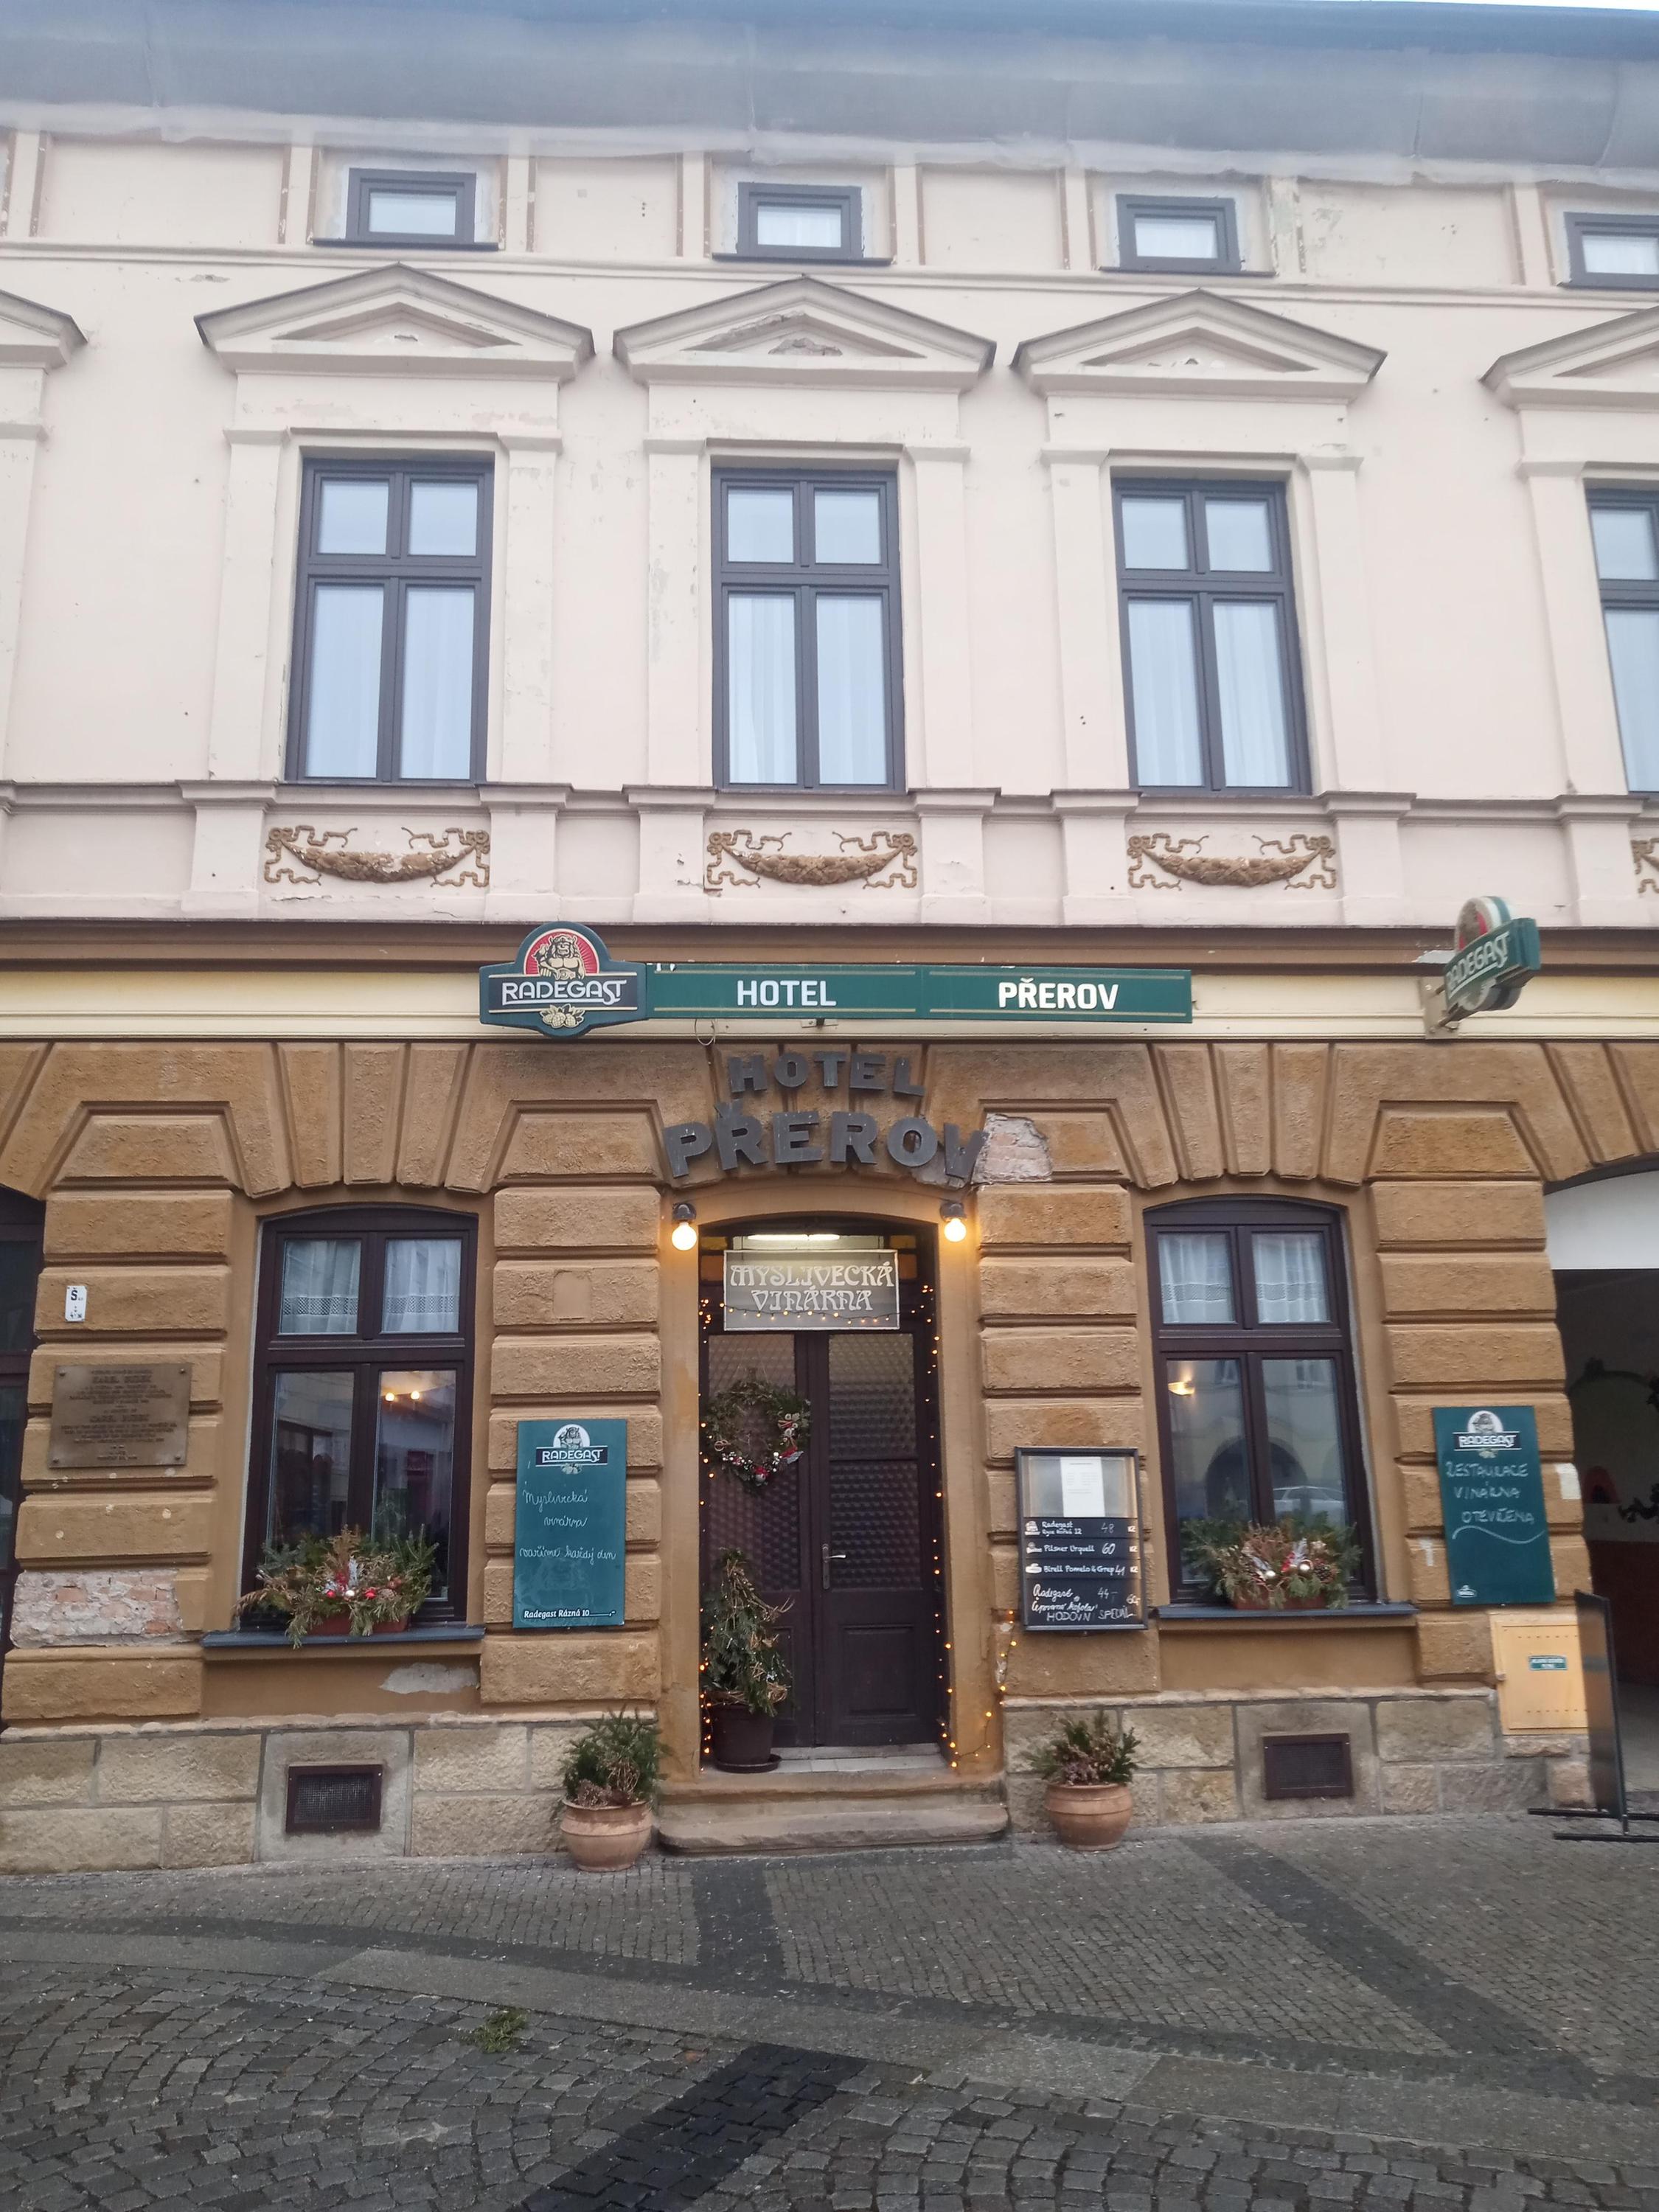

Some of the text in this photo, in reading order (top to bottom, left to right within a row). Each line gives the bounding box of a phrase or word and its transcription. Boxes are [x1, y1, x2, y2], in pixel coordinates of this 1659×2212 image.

[502, 980, 627, 1006] RADEGAST
[737, 978, 1119, 1009] HOTEL PŘEROV
[727, 1051, 926, 1097] HOTEL
[664, 1098, 990, 1179] PŘEROV
[730, 1262, 894, 1287] MYSLIVECKÁ
[751, 1285, 873, 1311] VINÁRNA
[1458, 1435, 1517, 1447] RADEGAST
[542, 1449, 603, 1463] RADEGAST
[1069, 1545, 1095, 1555] Urquell
[1102, 1543, 1116, 1555] 60
[524, 1610, 556, 1619] Radegast
[558, 1609, 580, 1618] Rázná
